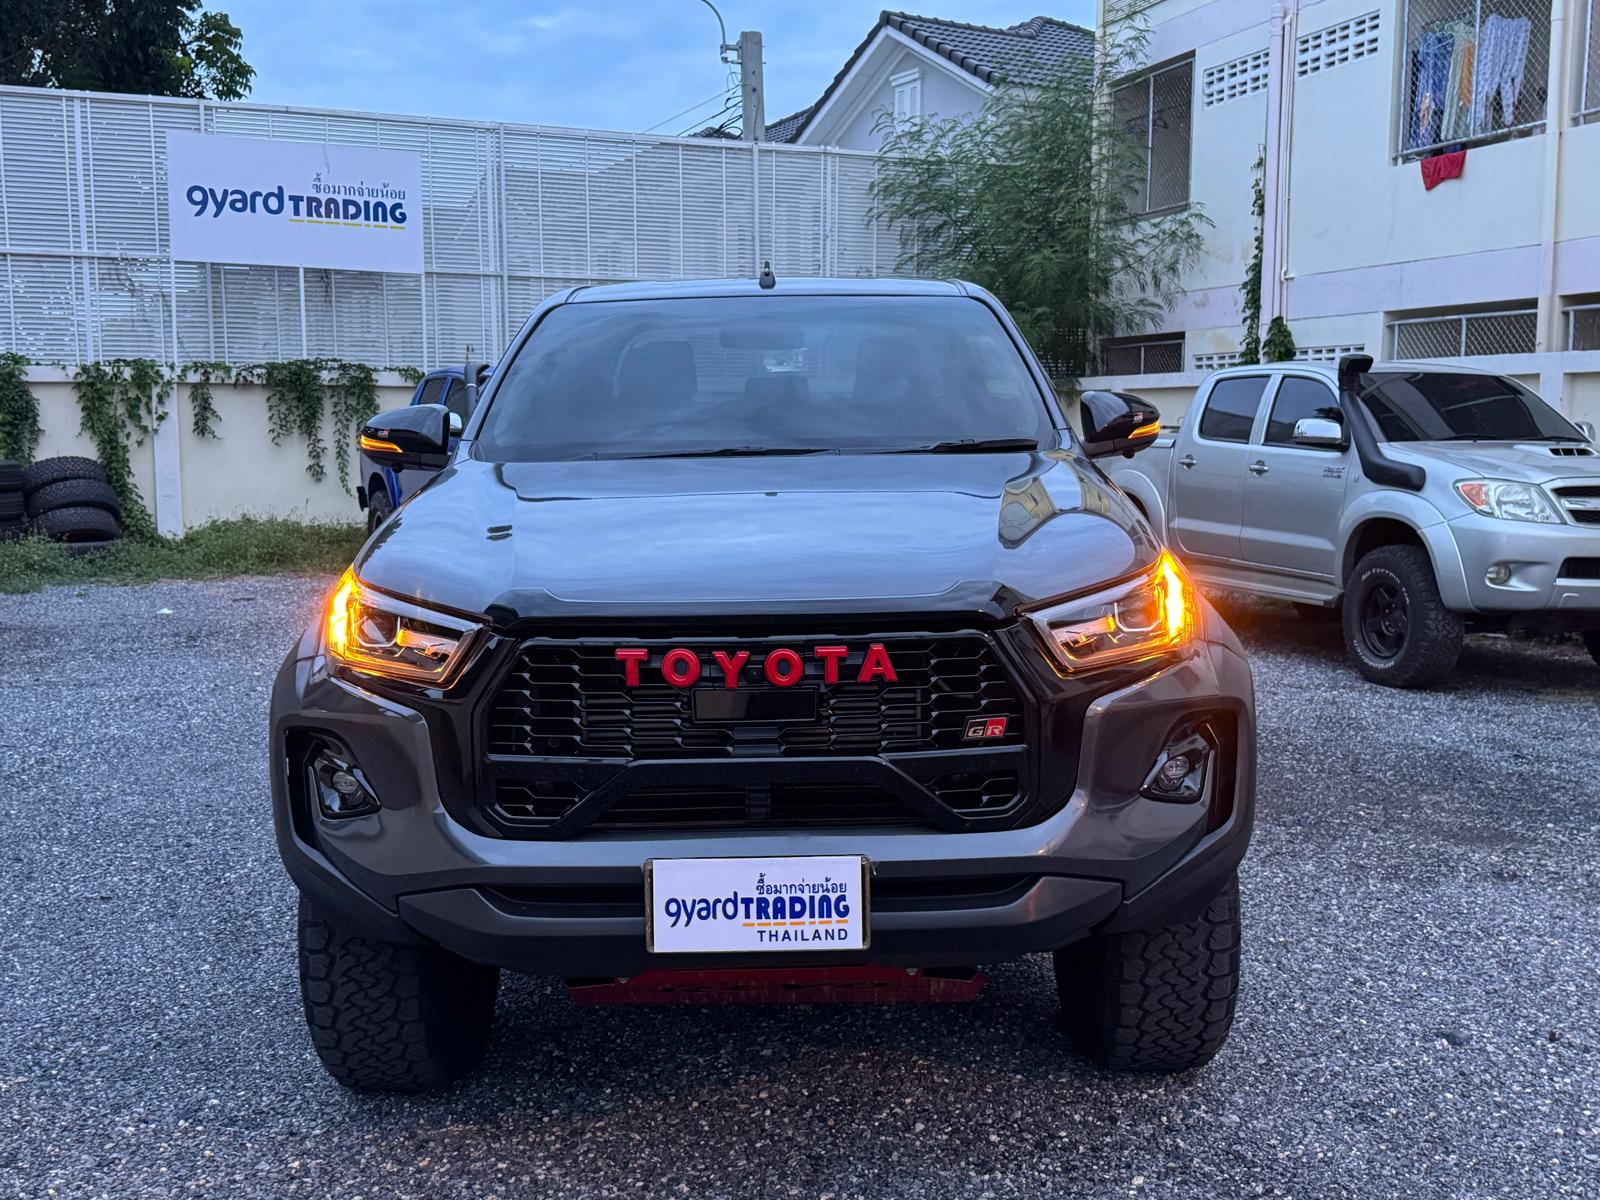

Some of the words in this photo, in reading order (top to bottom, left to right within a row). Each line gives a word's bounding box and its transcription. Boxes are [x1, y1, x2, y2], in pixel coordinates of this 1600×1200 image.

[312, 172, 406, 200] ซื้อมากจ่ายน้อย
[186, 184, 285, 219] 9yard
[288, 194, 407, 224] TRADING
[614, 642, 898, 689] TOYOTA
[967, 725, 1004, 737] GR
[755, 872, 848, 895] ซื้อมากจ่ายน้อย
[664, 891, 739, 928] 9yard
[740, 894, 850, 920] TRADING
[756, 928, 849, 942] THAILAND
